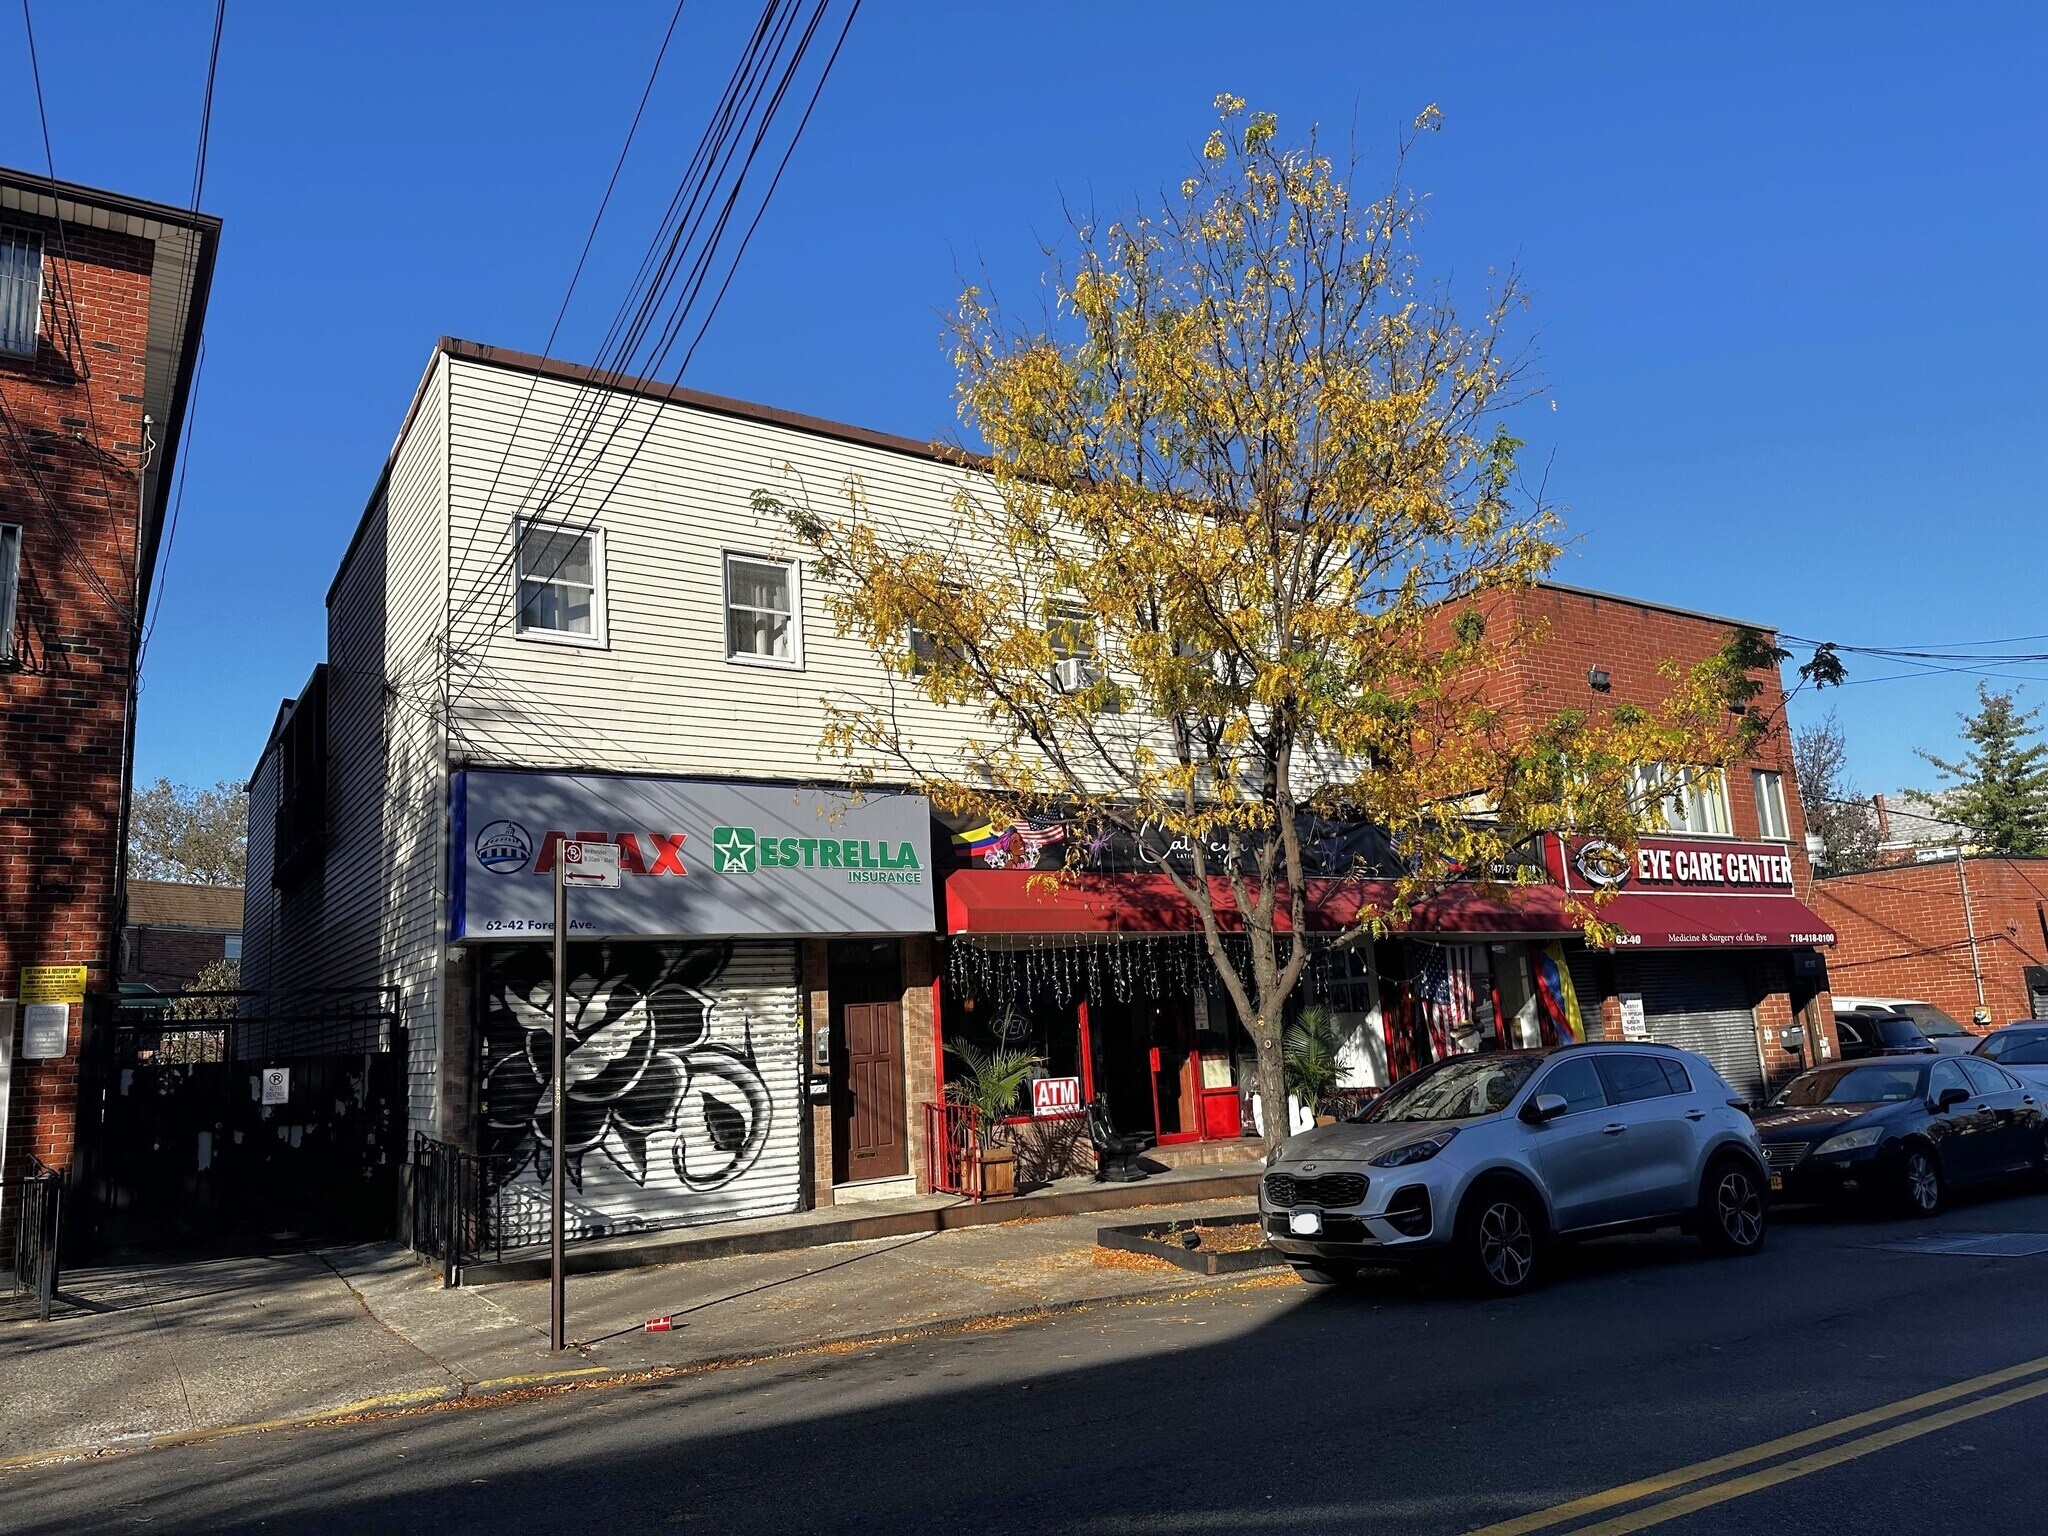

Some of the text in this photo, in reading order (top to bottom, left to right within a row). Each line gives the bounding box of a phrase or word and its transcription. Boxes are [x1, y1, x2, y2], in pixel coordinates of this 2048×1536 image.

[533, 831, 688, 876] AAX
[760, 837, 921, 869] ESTRELLA
[848, 871, 922, 884] INSURANCE
[1637, 849, 1792, 885] EYE CARE CENTER
[486, 920, 596, 931] 62-42 Fore Ave.
[1615, 933, 1835, 945] 62-40 Medicine & Surgery of the Eye 718-418-0100
[992, 1019, 1028, 1035] OEN
[1037, 1080, 1076, 1107] ATM
